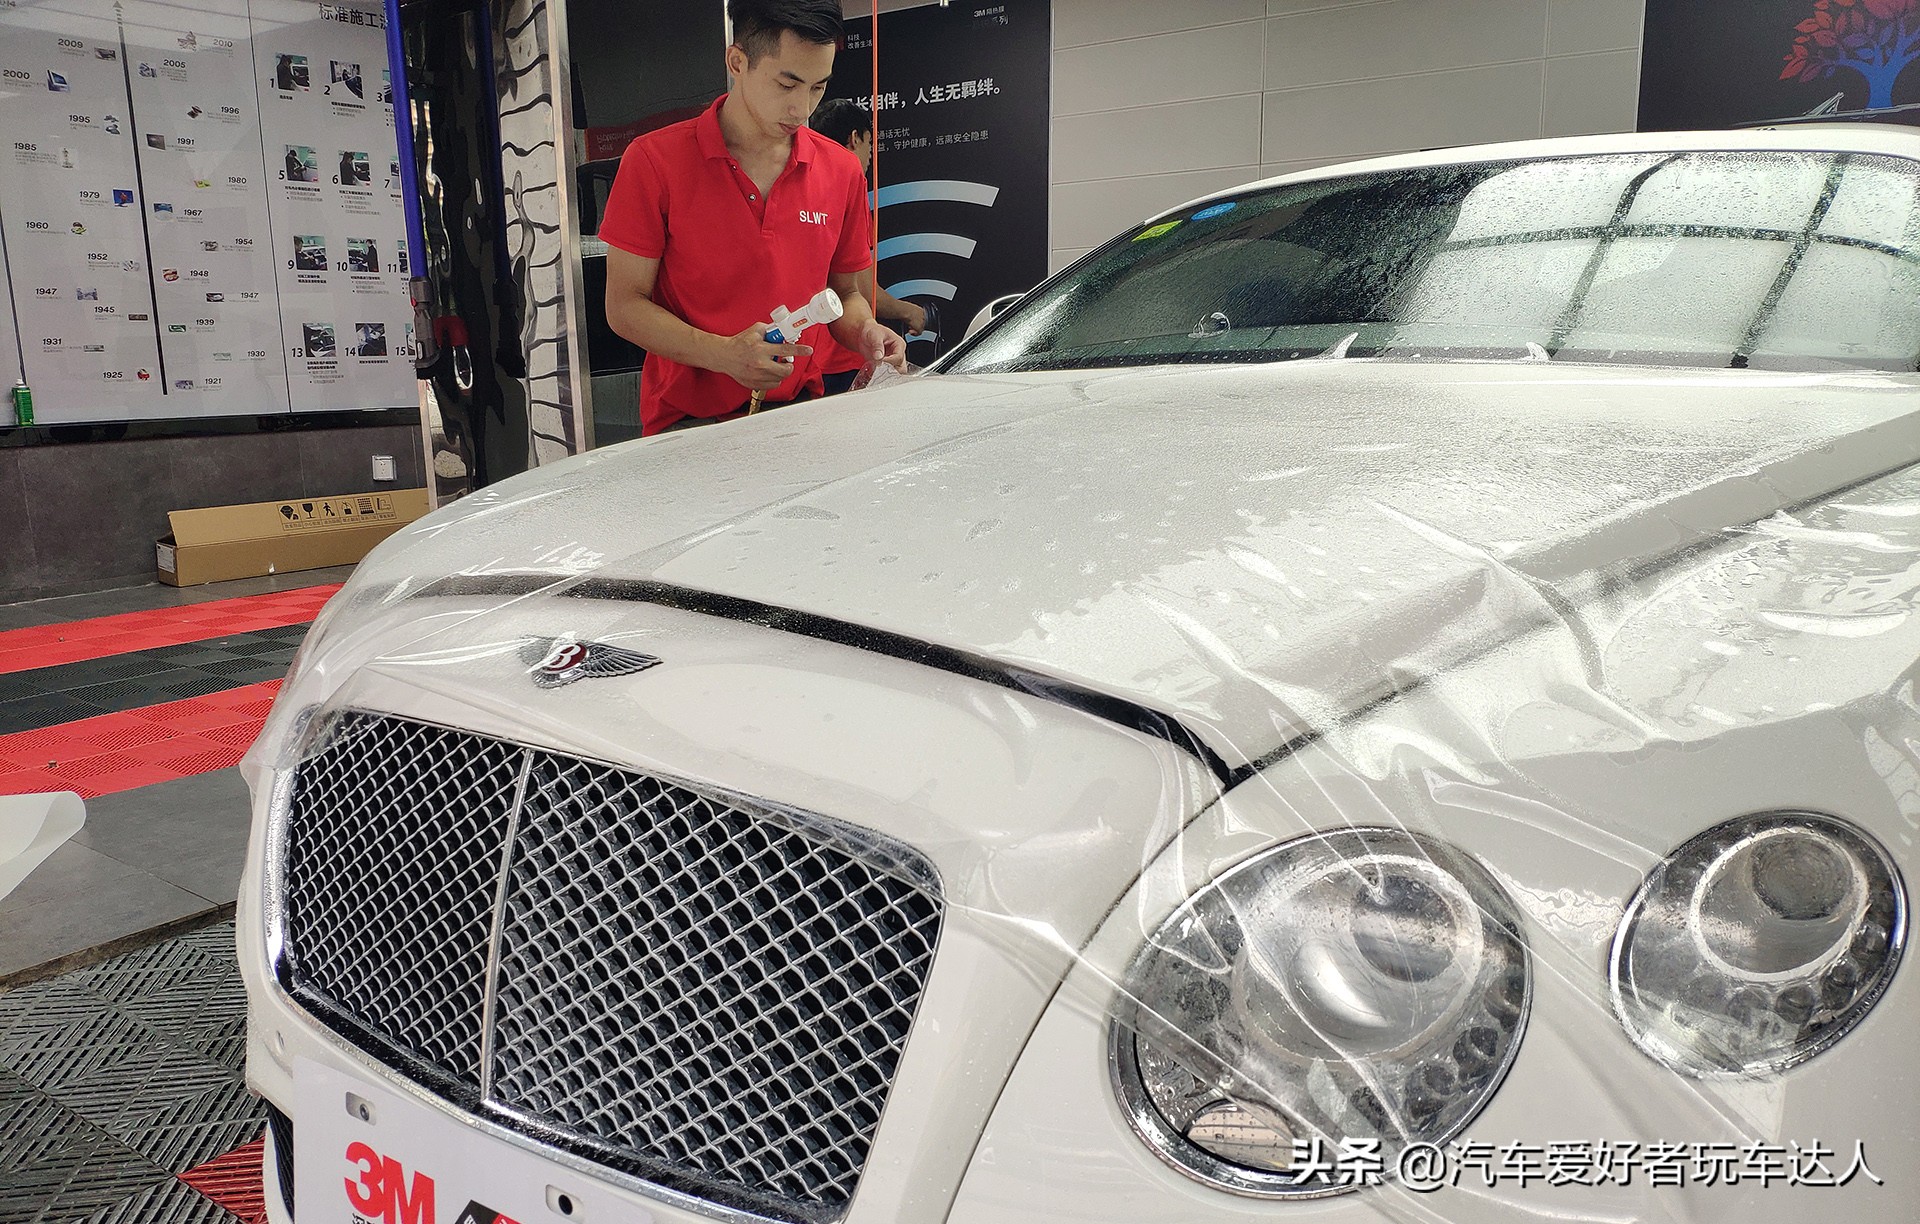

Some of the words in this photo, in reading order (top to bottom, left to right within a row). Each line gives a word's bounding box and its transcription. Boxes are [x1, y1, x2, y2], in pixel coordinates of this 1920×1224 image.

[973, 10, 986, 18] 3M
[58, 38, 84, 49] 2009
[163, 59, 186, 69] 2005
[3, 69, 31, 80] 2000
[269, 78, 275, 89] 1
[323, 85, 331, 96] 2
[846, 77, 1001, 112] 长相伴，人生无羁绊。
[376, 92, 383, 103] 3
[221, 106, 240, 115] 1996
[69, 114, 91, 124] 1995
[177, 137, 195, 146] 1991
[14, 142, 37, 151] 1985
[278, 169, 286, 180] 5
[228, 176, 247, 185] 1980
[332, 174, 339, 185] 6
[384, 179, 390, 189] 7
[79, 190, 100, 199] 1979
[183, 209, 203, 217] 1967
[799, 210, 828, 226] SLWT
[25, 221, 49, 230] 1960
[235, 238, 253, 246] 1954
[87, 252, 108, 261] 1952
[287, 259, 295, 270] 9
[336, 261, 348, 272] 10
[387, 263, 397, 273] 11
[190, 269, 210, 278] 1948
[35, 287, 58, 296] 1947
[240, 291, 259, 299] 1947
[94, 305, 115, 314] 1945
[195, 318, 215, 326] 1939
[42, 337, 62, 346] 1931
[247, 350, 266, 358] 1930
[291, 347, 304, 358] 13
[344, 346, 356, 357] 14
[395, 346, 406, 356] 15
[102, 370, 123, 379] 1925
[204, 377, 222, 385] 1921
[344, 1141, 436, 1224] 3M
